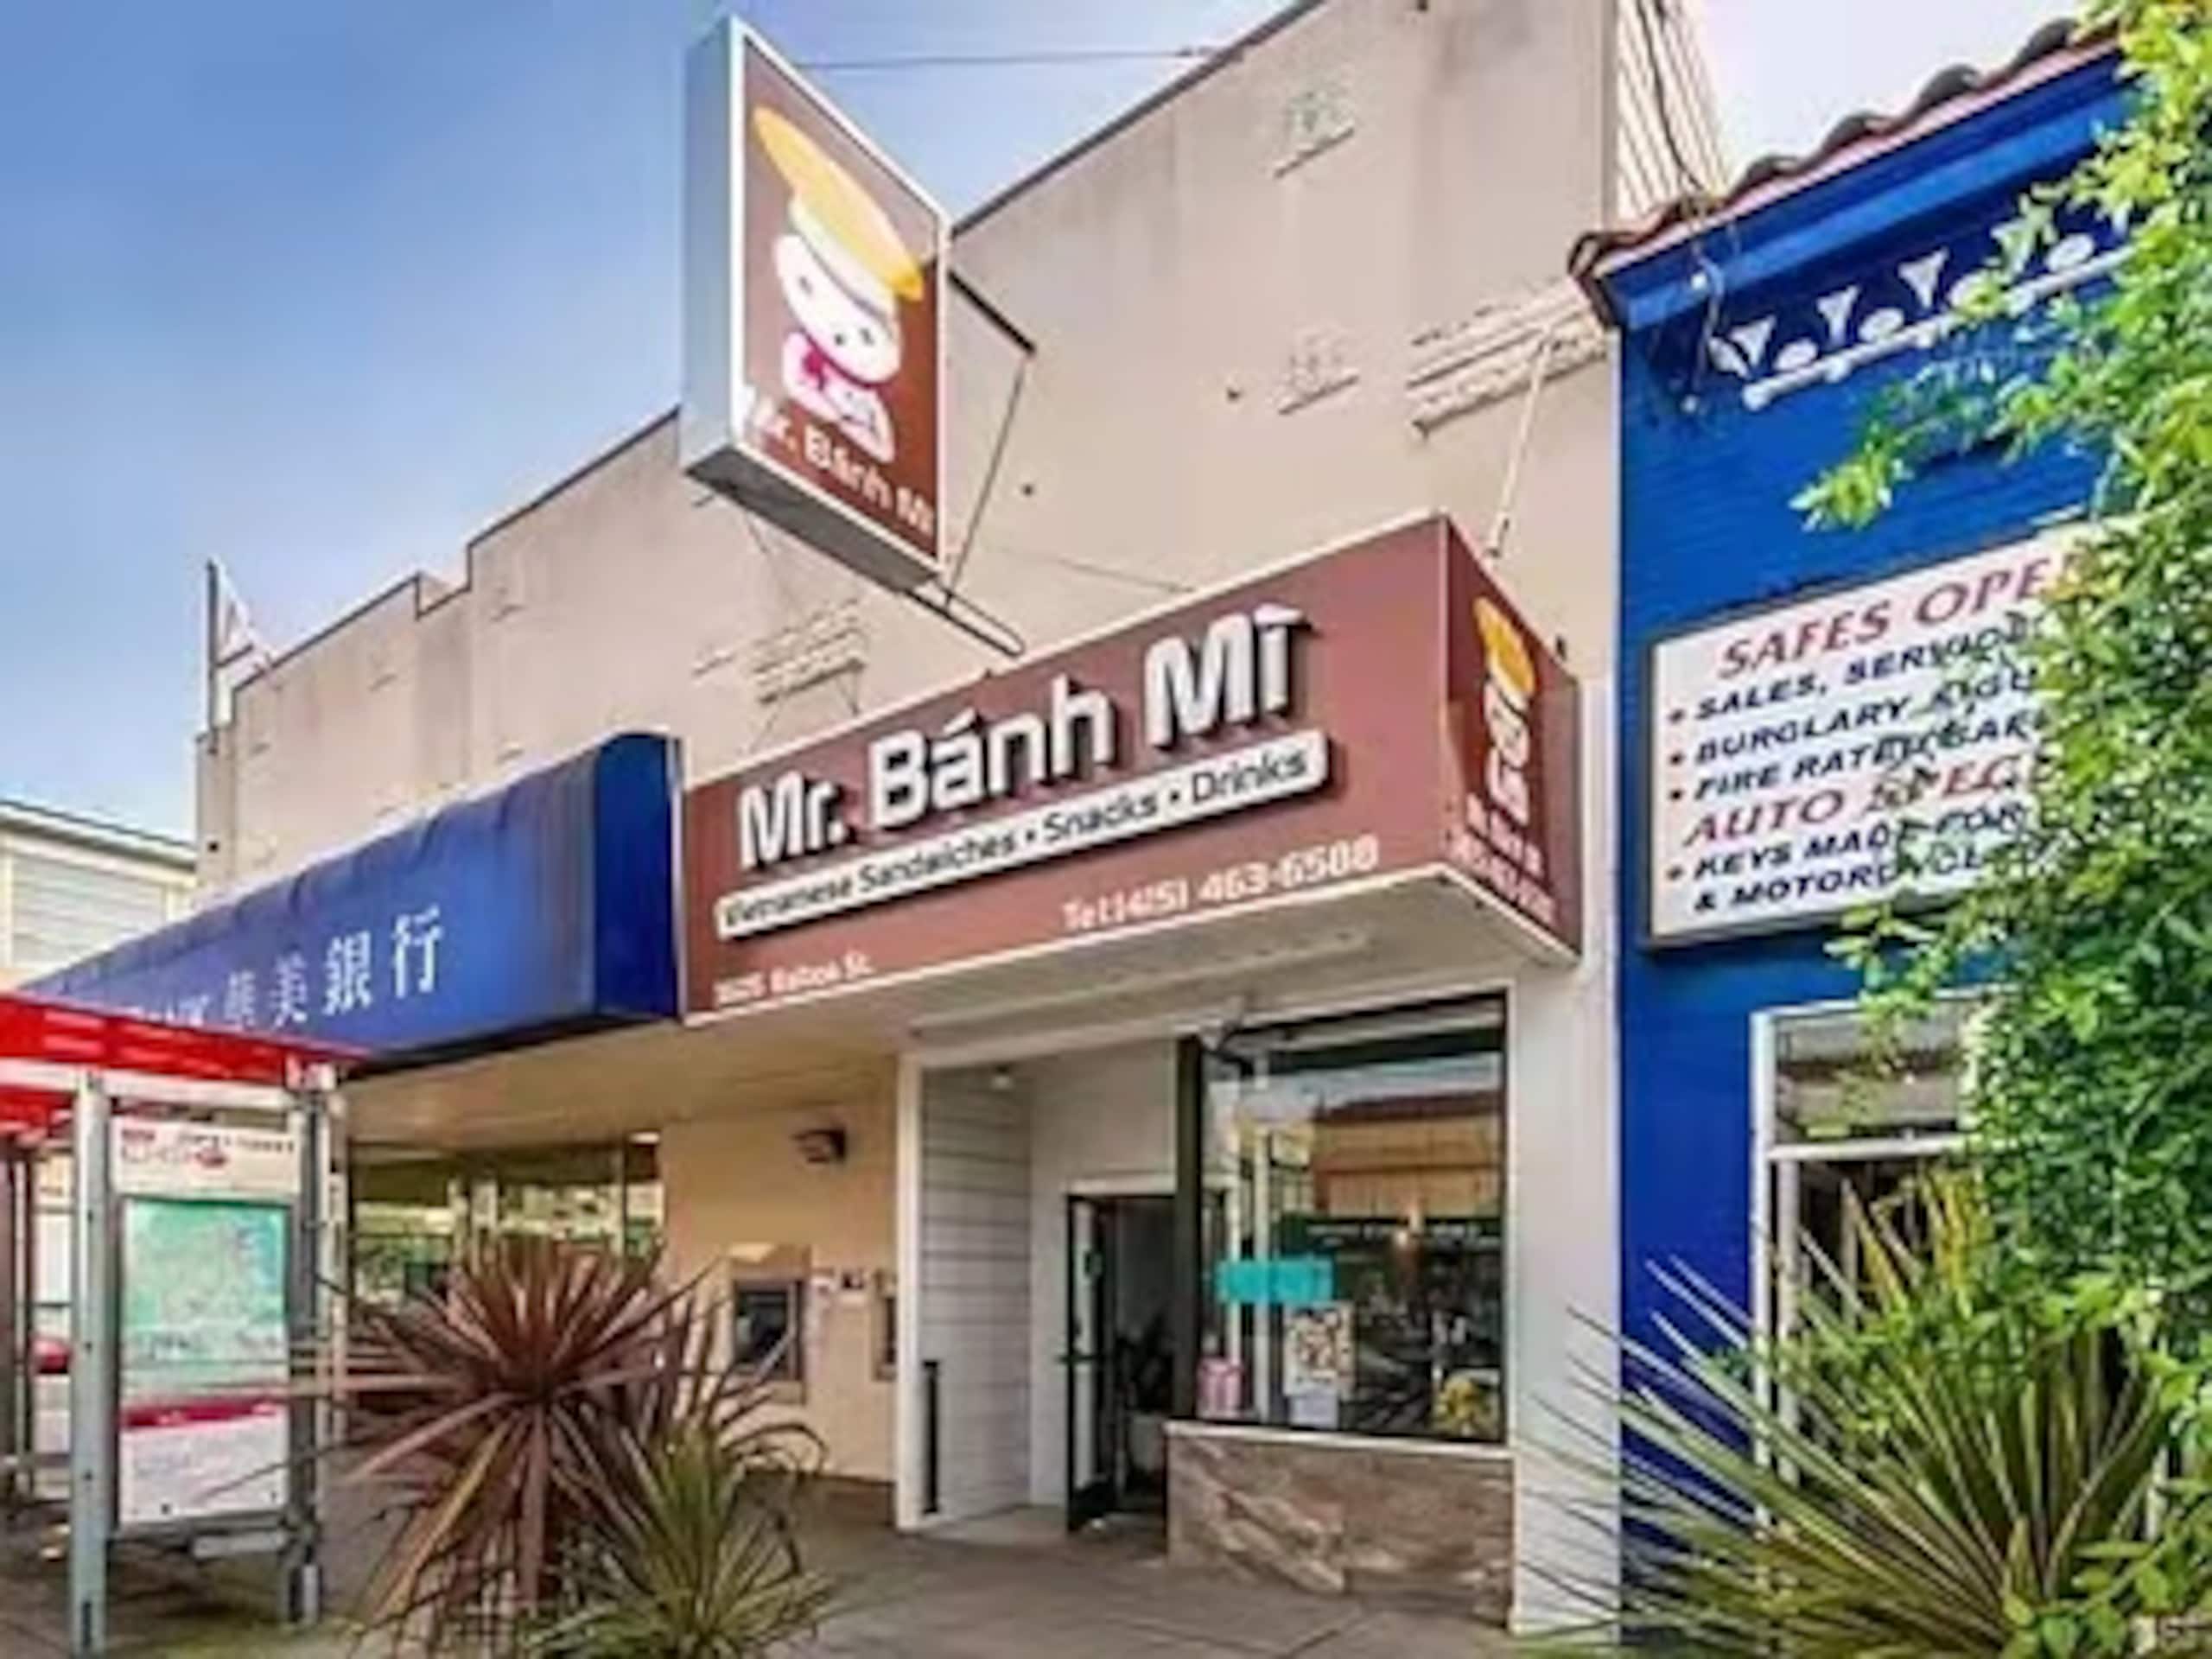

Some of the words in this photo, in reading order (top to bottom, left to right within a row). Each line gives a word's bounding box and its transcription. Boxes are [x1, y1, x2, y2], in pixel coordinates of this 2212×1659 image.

[1718, 598, 1892, 680] SAFES
[1695, 673, 1828, 721] SALES,
[1696, 696, 1911, 765] BURGLARY
[739, 769, 850, 870] Mr.
[870, 674, 1113, 831] Bánh
[1042, 788, 1160, 842] Snacks
[1191, 747, 1308, 804] Drinks
[1694, 766, 1780, 801] FIRE
[1681, 787, 1846, 848] AUTO
[1694, 842, 1792, 880] KEYS
[1694, 892, 1717, 911] &
